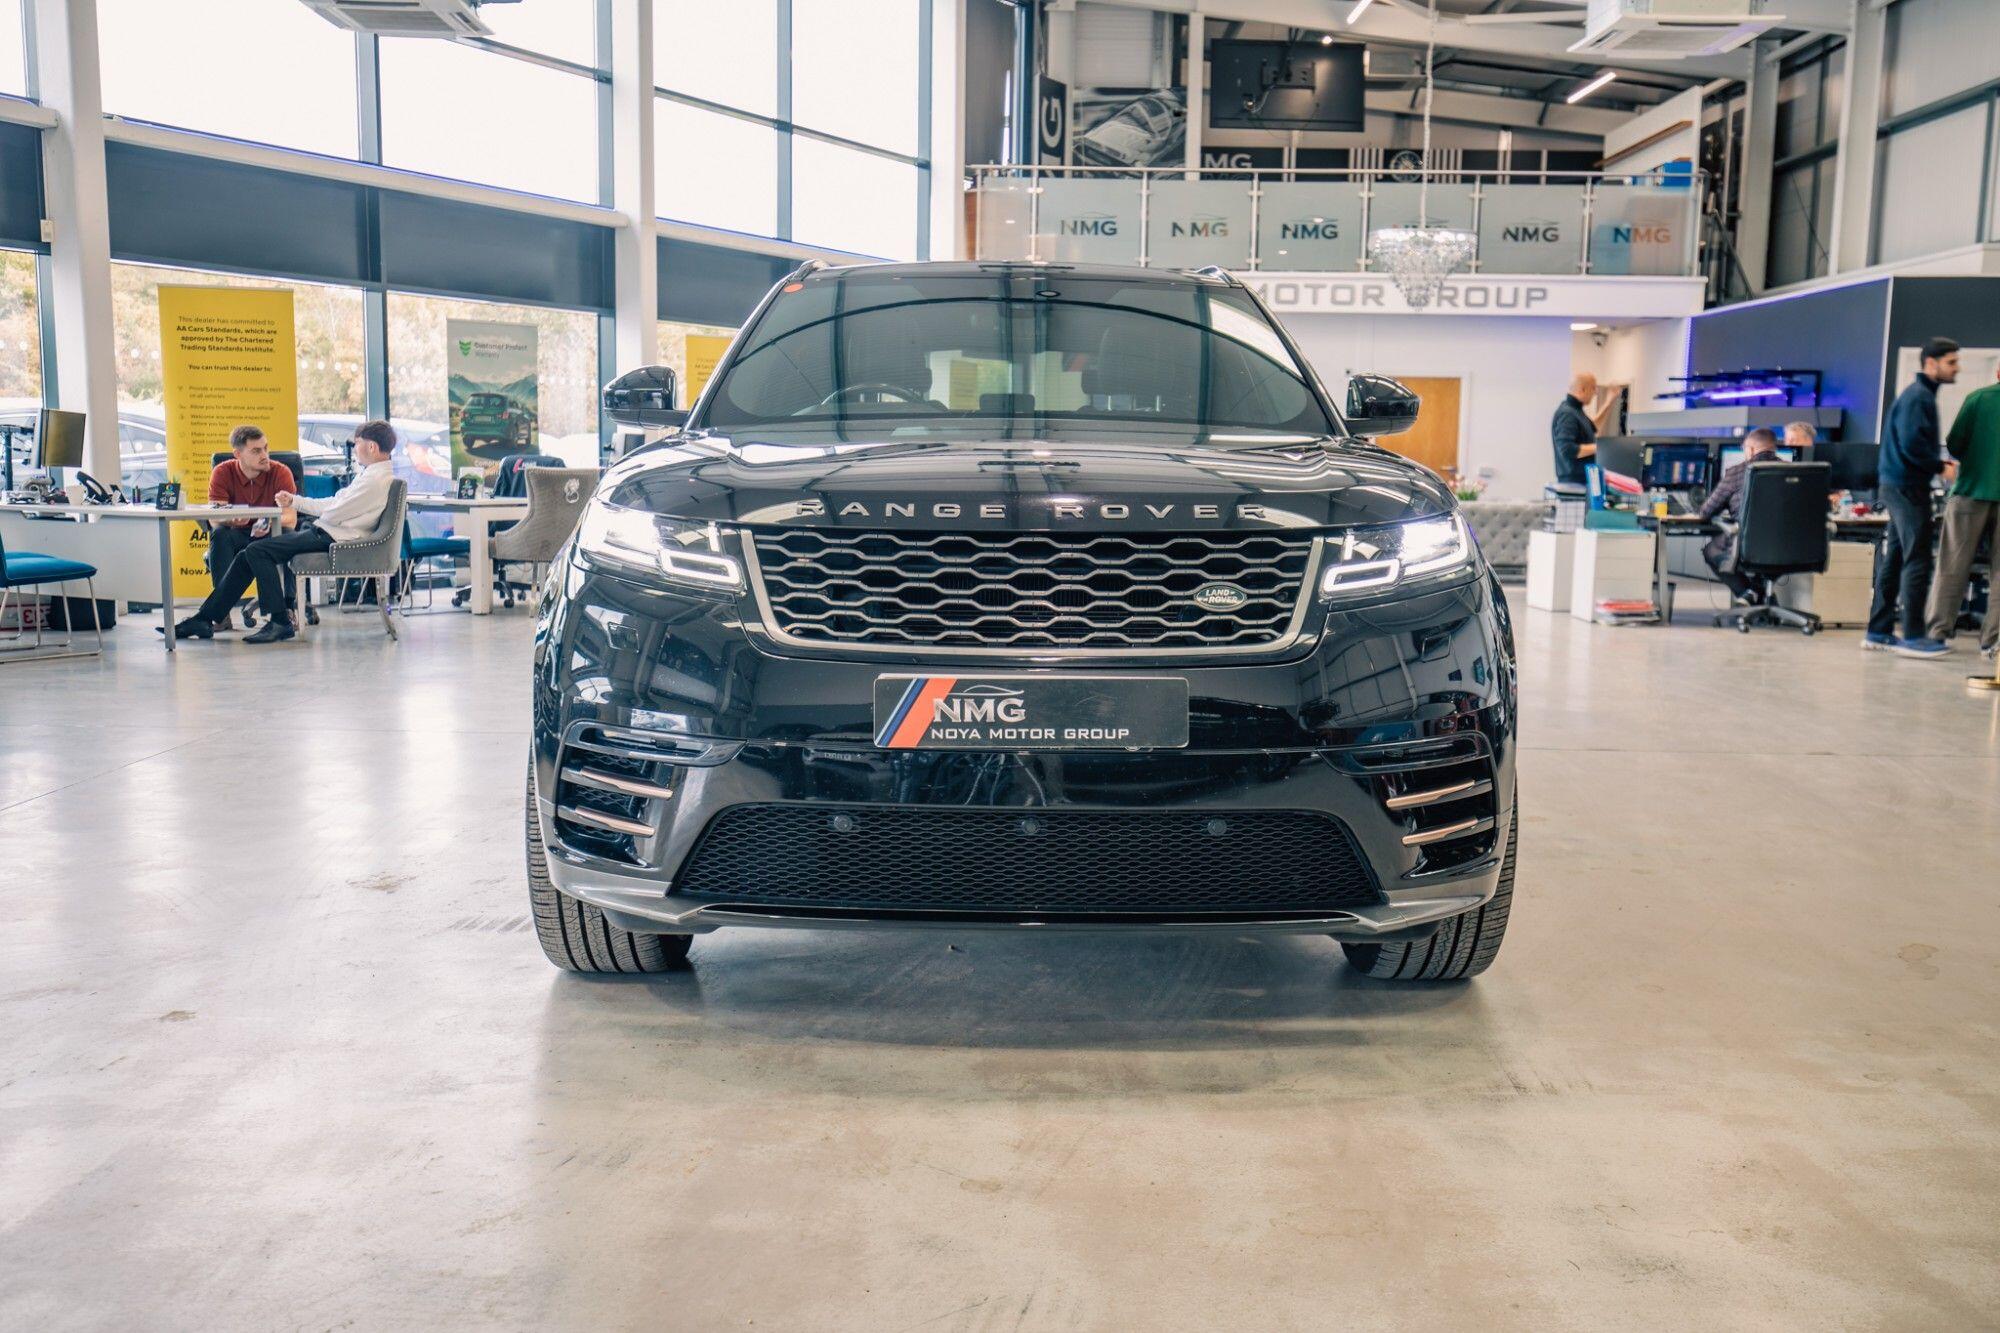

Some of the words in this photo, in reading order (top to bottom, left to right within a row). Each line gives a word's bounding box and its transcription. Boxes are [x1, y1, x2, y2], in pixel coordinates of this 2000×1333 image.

[1060, 219, 1118, 236] NMG
[1171, 221, 1229, 238] NMG
[1281, 223, 1338, 240] NMG
[1502, 227, 1560, 243] NMG
[1613, 227, 1672, 243] NMG
[188, 325, 204, 333] Cars
[206, 326, 243, 335] Standards,
[180, 343, 207, 352] Trading
[208, 344, 243, 352] Standards
[797, 499, 1007, 518] RANGE
[1054, 503, 1266, 519] ROVER
[190, 529, 208, 541] AA
[180, 567, 203, 575] Now
[1205, 589, 1230, 597] LAND
[1208, 595, 1238, 604] ROVER
[932, 697, 1027, 723] NMG
[931, 728, 982, 740] NOYA
[989, 728, 1056, 740] MOTOR
[1064, 728, 1130, 740] GROUP
